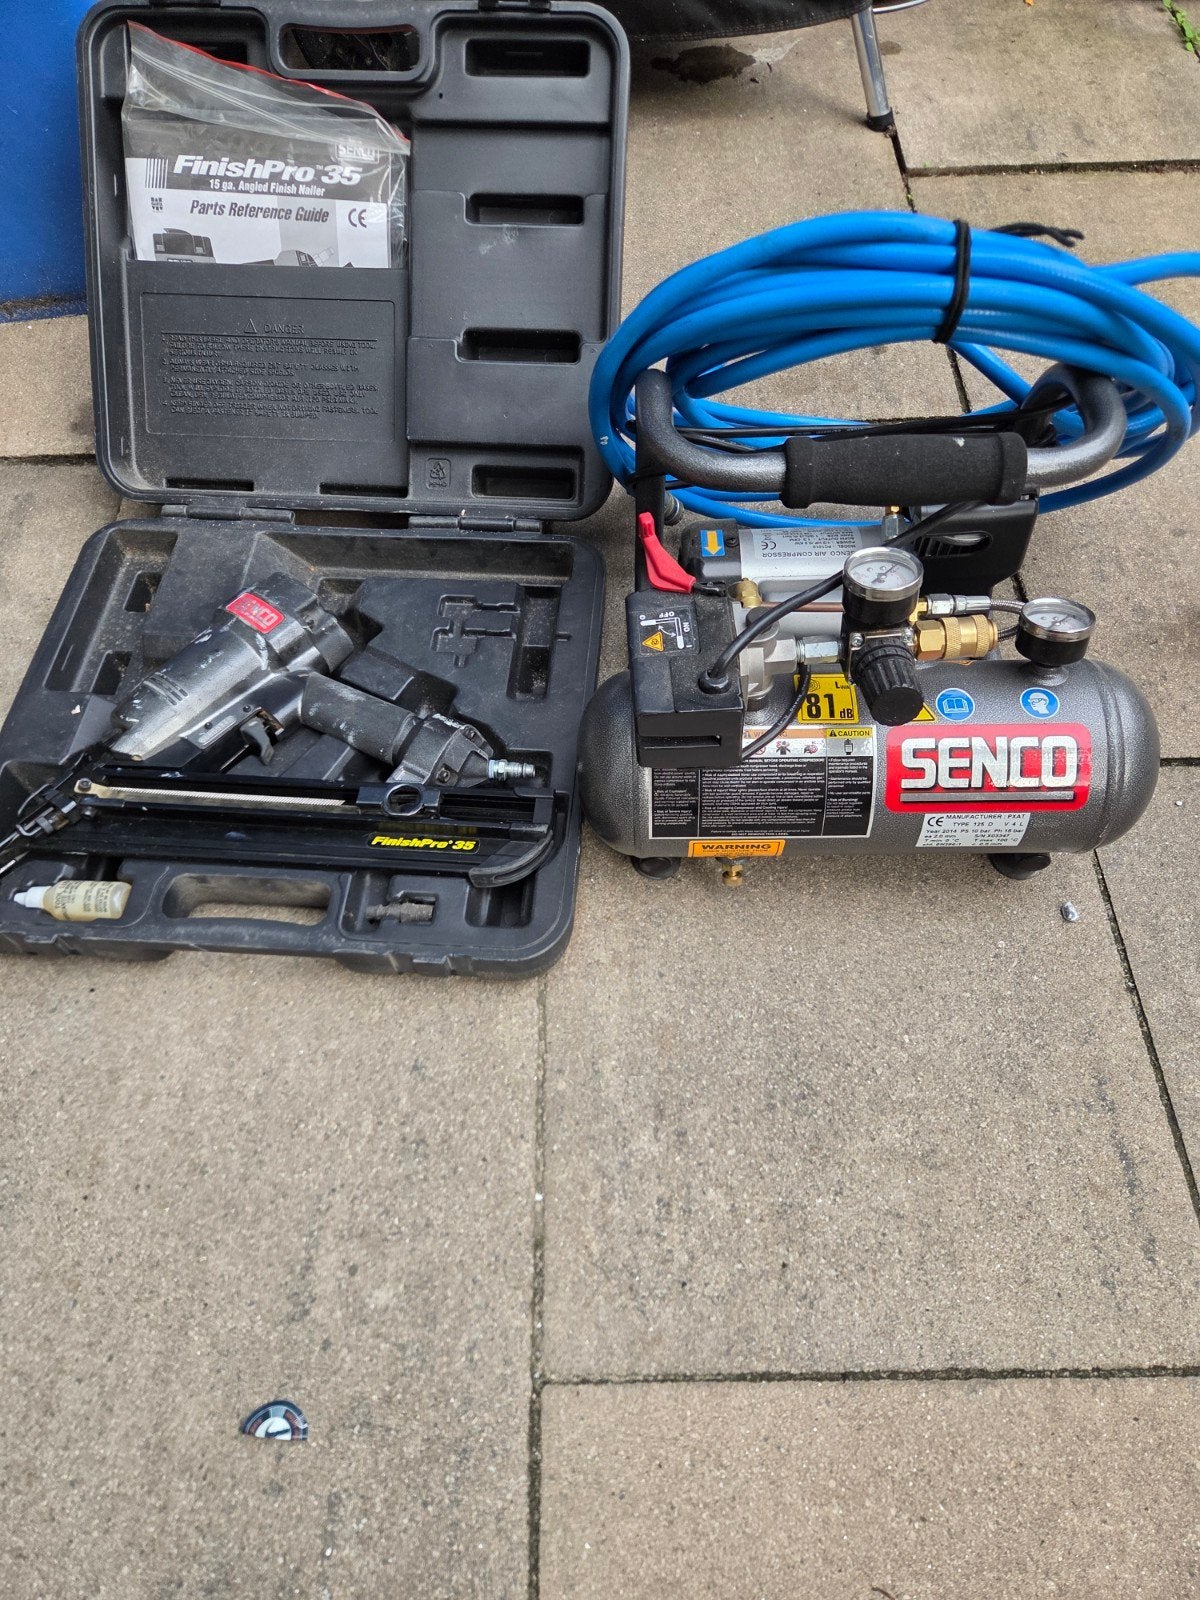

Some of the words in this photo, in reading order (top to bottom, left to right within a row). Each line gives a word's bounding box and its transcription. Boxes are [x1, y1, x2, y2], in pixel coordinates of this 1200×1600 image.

[321, 165, 363, 186] 35
[209, 178, 221, 189] 15
[222, 180, 236, 192] ga.
[238, 180, 268, 194] Angled
[270, 182, 297, 195] Finish
[298, 184, 325, 196] Nailer
[190, 200, 225, 217] Parts
[228, 202, 291, 220] Reference
[294, 206, 329, 222] Guide
[264, 323, 304, 335] DANGER
[761, 541, 777, 550] CE
[682, 622, 690, 632] ON
[805, 693, 836, 719] 81
[840, 708, 854, 719] dB
[901, 736, 1078, 789] SENCO
[927, 816, 944, 827] CE
[452, 840, 476, 850] 35
